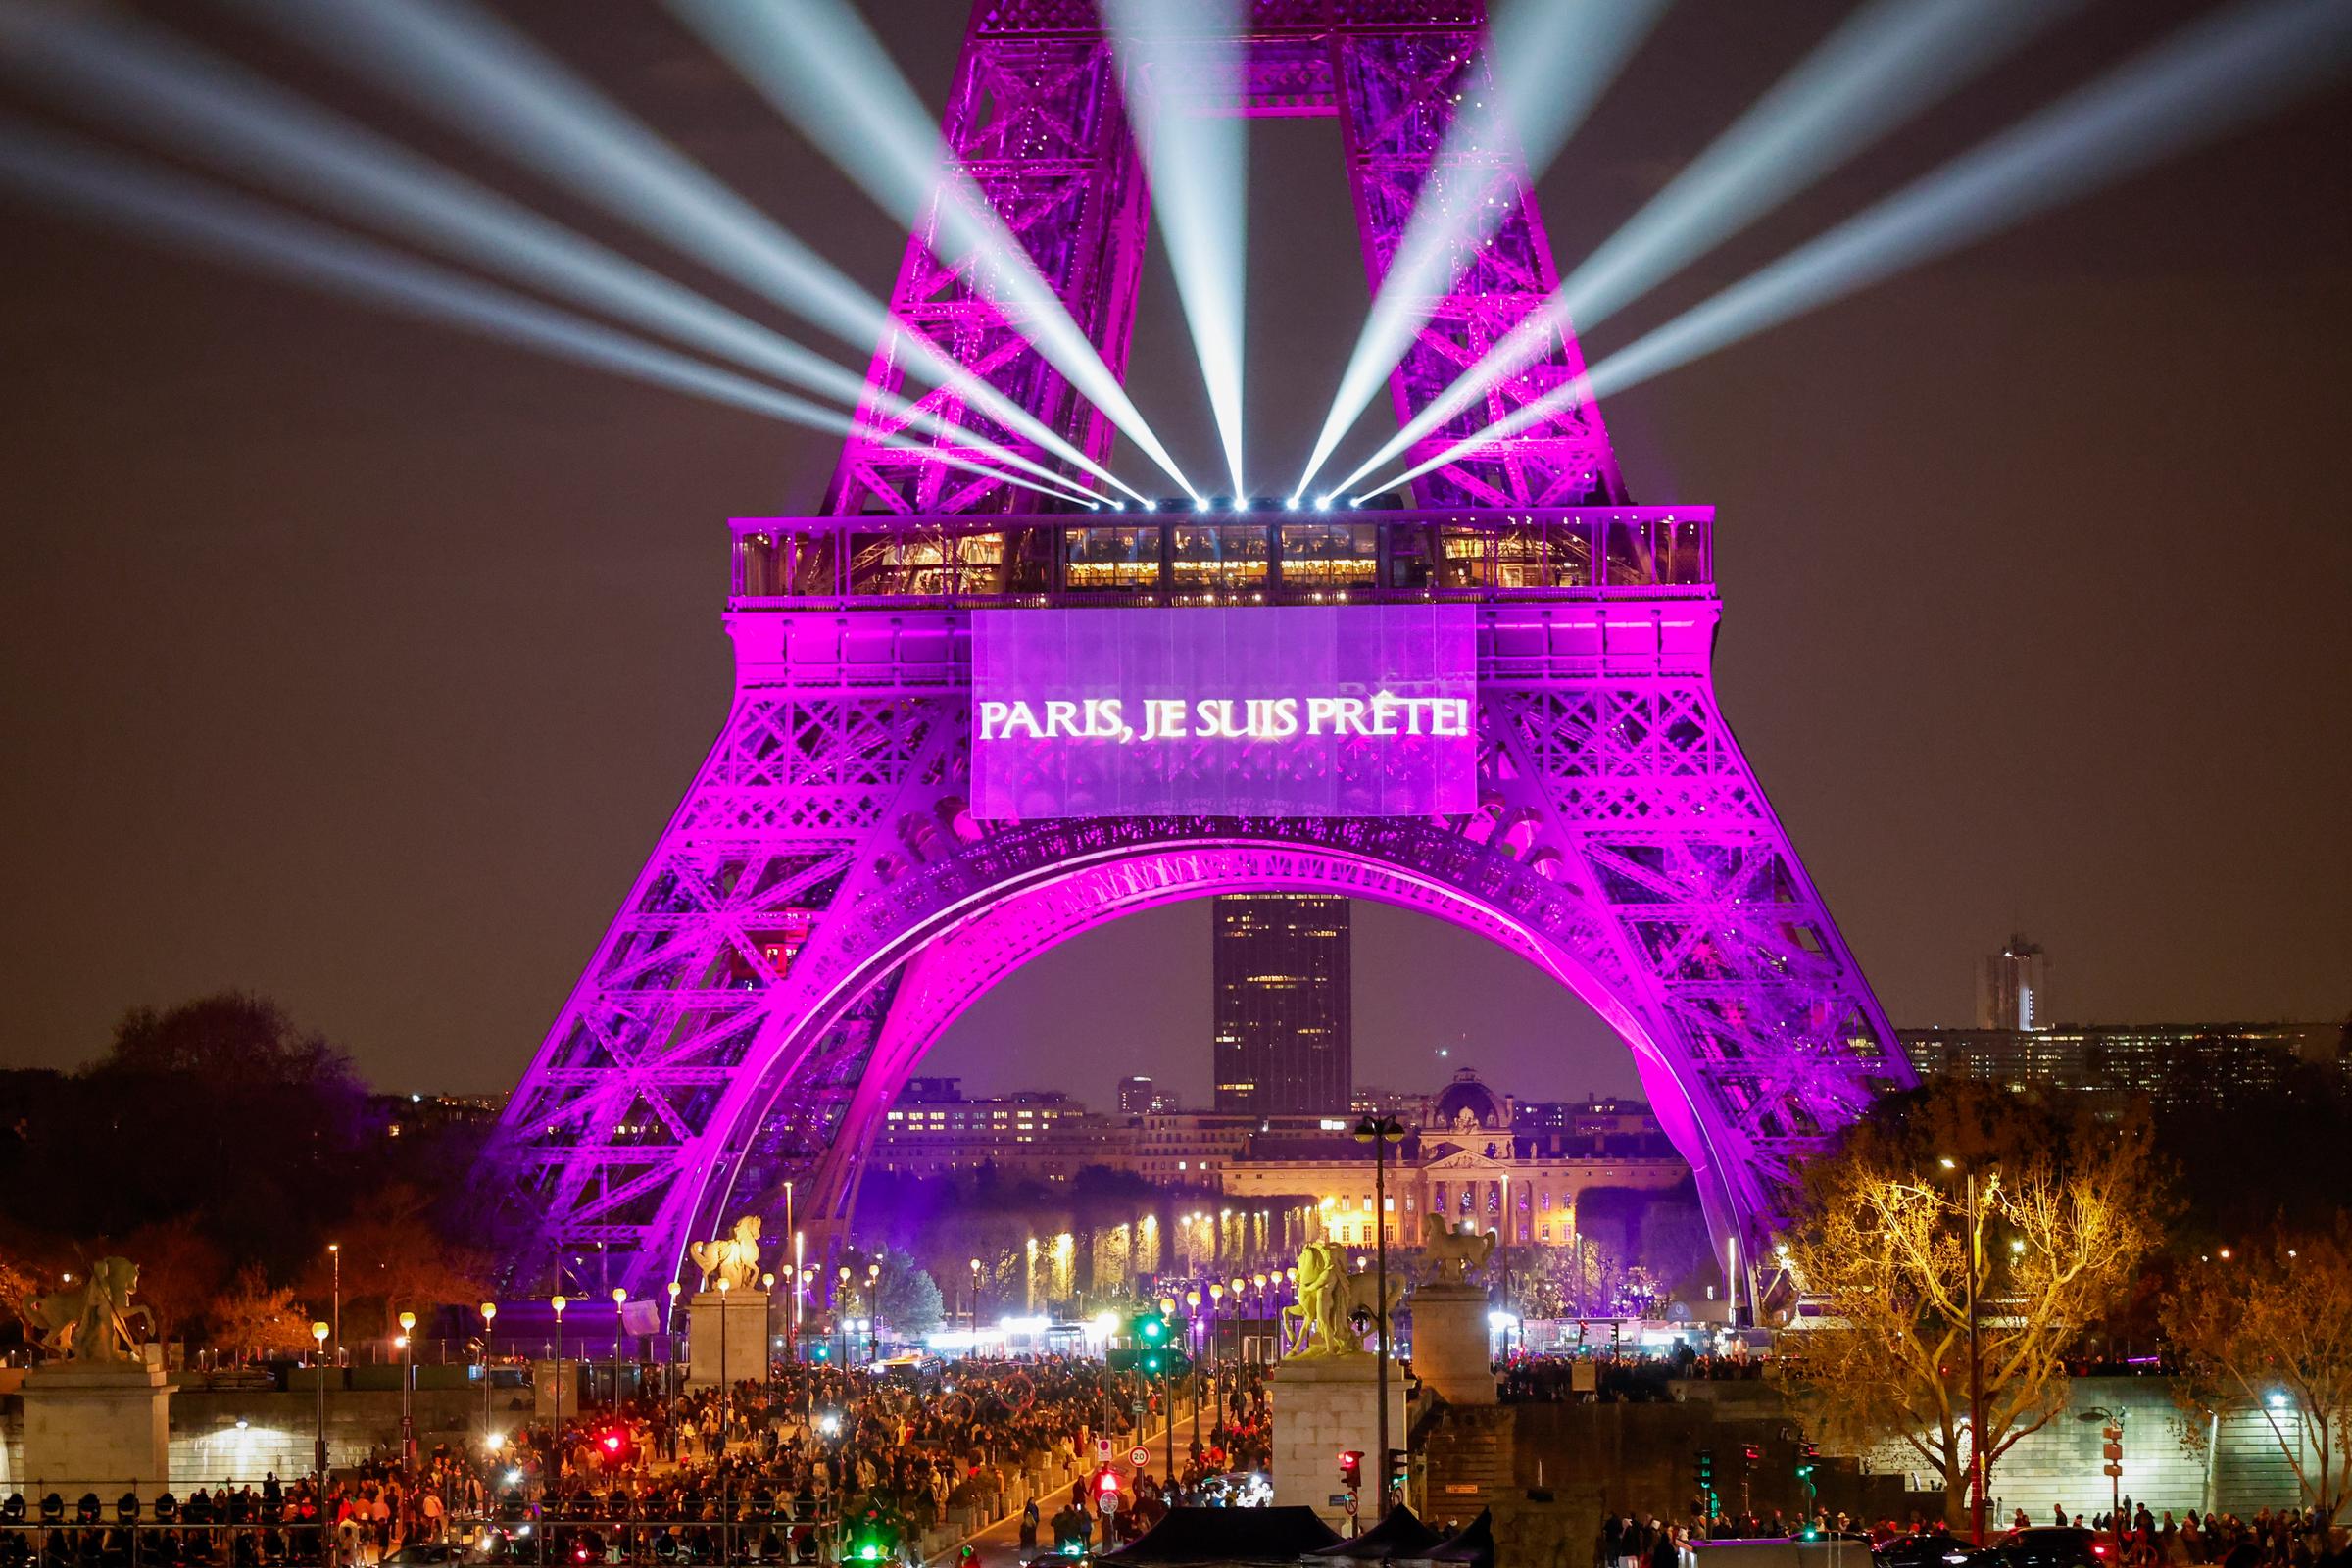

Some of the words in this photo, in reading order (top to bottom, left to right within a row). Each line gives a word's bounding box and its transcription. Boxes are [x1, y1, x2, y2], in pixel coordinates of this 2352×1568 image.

[979, 699, 1133, 743] PARIS,
[1139, 699, 1186, 741] JE
[1196, 698, 1298, 738] SUIS
[1306, 690, 1468, 736] PRÊTE!
